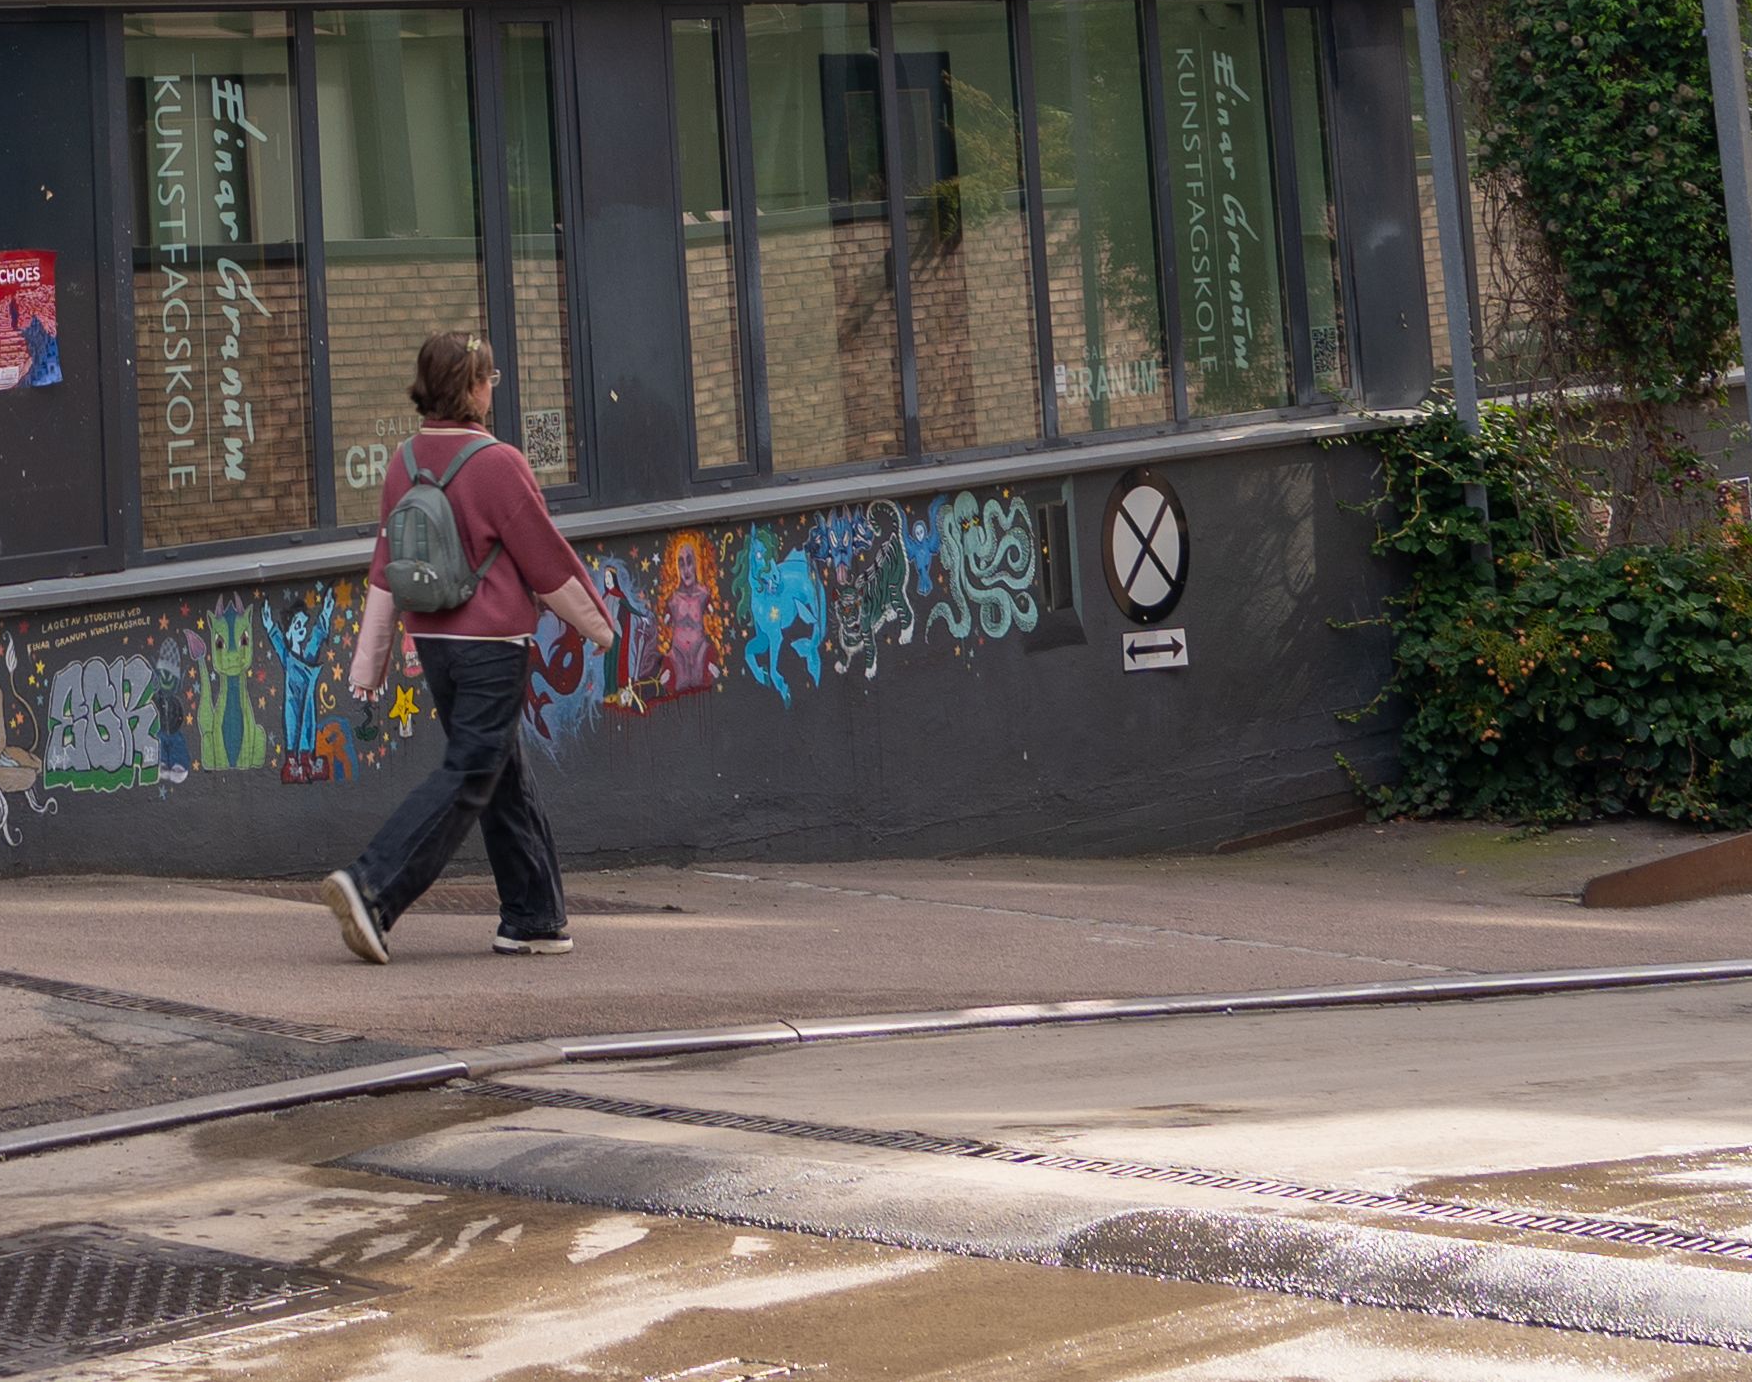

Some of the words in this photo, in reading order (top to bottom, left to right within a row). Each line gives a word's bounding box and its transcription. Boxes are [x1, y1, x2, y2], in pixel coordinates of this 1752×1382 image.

[153, 74, 198, 490] KUNSTFAGSKOLE
[1175, 47, 1219, 375] KUNSTFAGSKOLE
[1065, 359, 1158, 405] GRANUM
[55, 631, 87, 649] GRANUM
